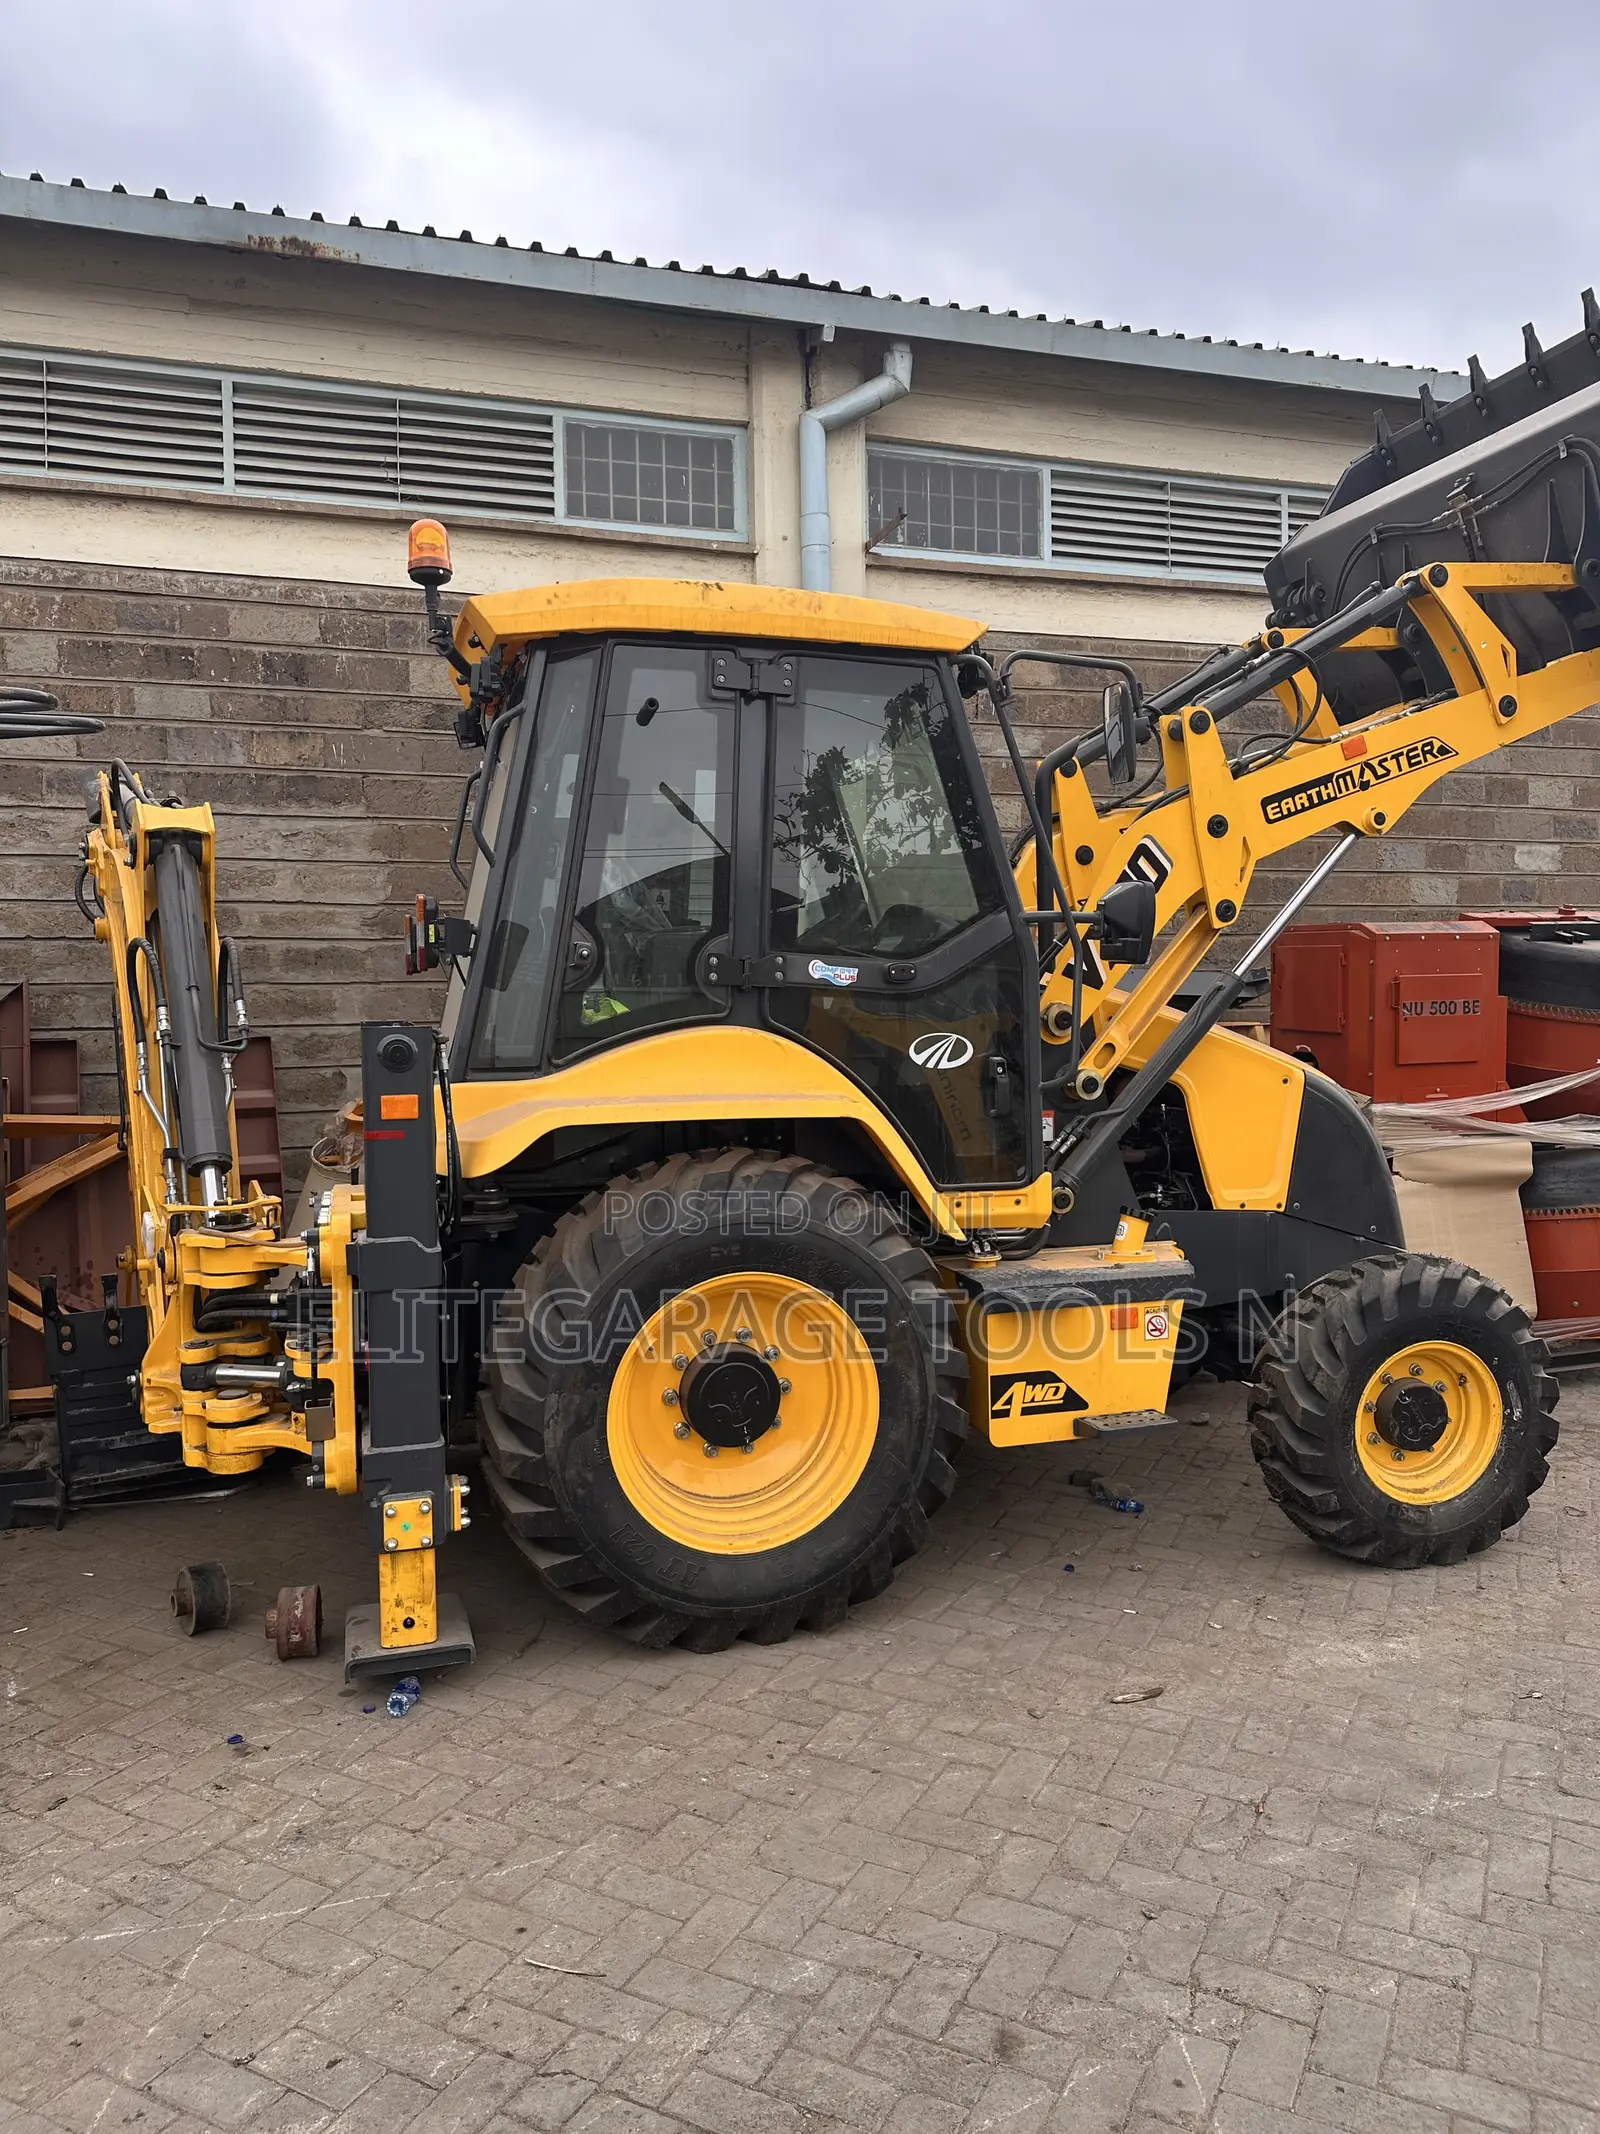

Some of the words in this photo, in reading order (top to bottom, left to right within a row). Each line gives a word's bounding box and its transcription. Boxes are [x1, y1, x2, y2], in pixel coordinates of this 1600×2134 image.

[1265, 740, 1440, 821] EARTHMASTER
[833, 973, 857, 982] PLUS
[1402, 1001, 1423, 1016] NU
[1429, 1000, 1457, 1015] 500
[1462, 1000, 1480, 1015] BE
[991, 1381, 1067, 1417] 4WD
